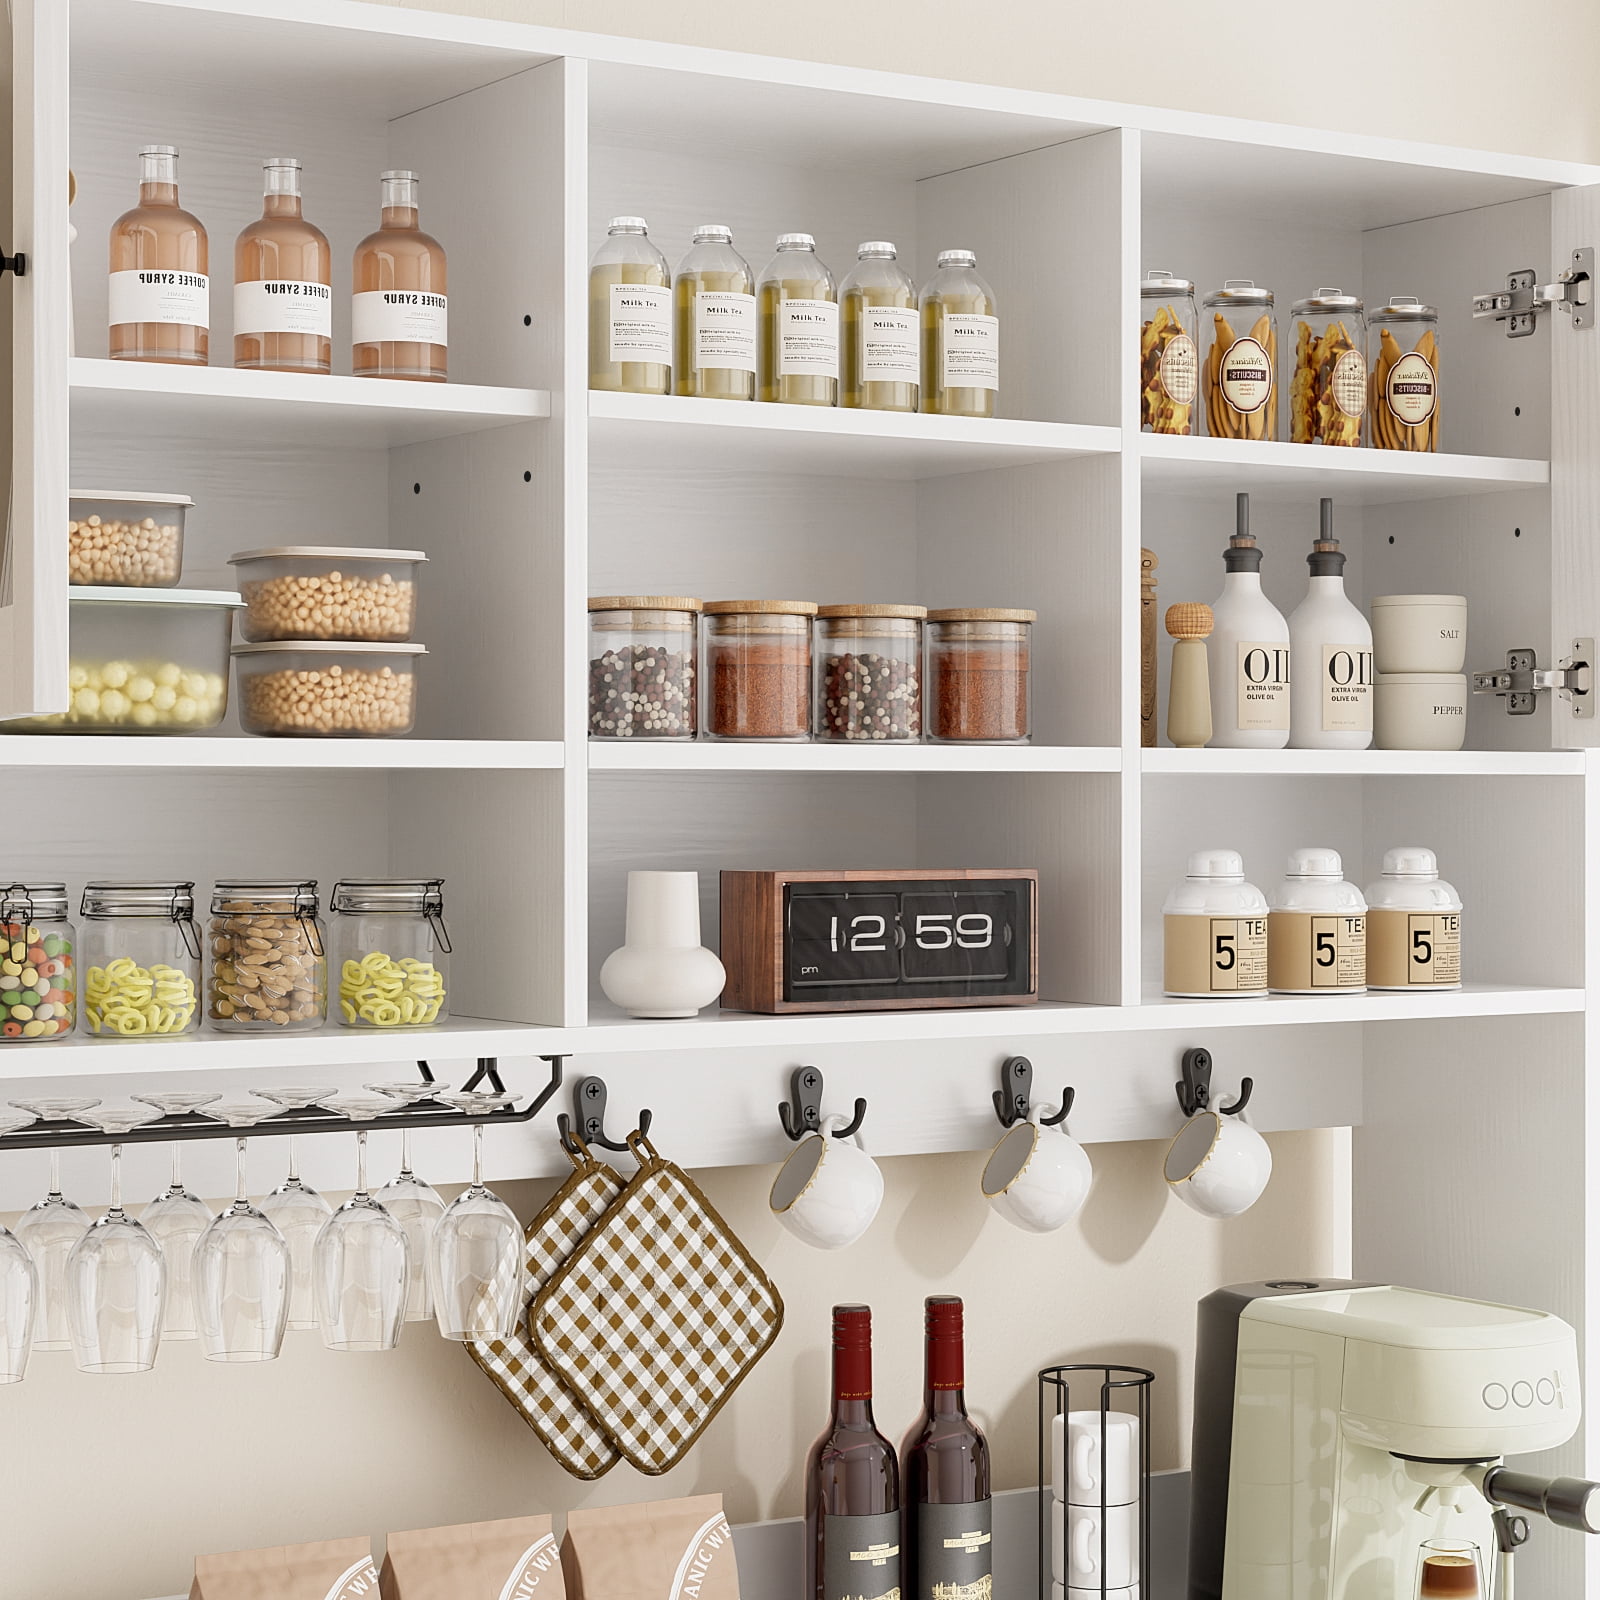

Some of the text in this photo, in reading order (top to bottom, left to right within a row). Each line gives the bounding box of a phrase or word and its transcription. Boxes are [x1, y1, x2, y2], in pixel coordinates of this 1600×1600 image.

[1439, 629, 1460, 639] SALT
[1432, 705, 1464, 715] PEPPER
[831, 913, 993, 952] 12 59
[1413, 930, 1432, 964] 5
[1215, 935, 1235, 970] 5
[1316, 933, 1335, 967] 5
[801, 966, 819, 975] pm
